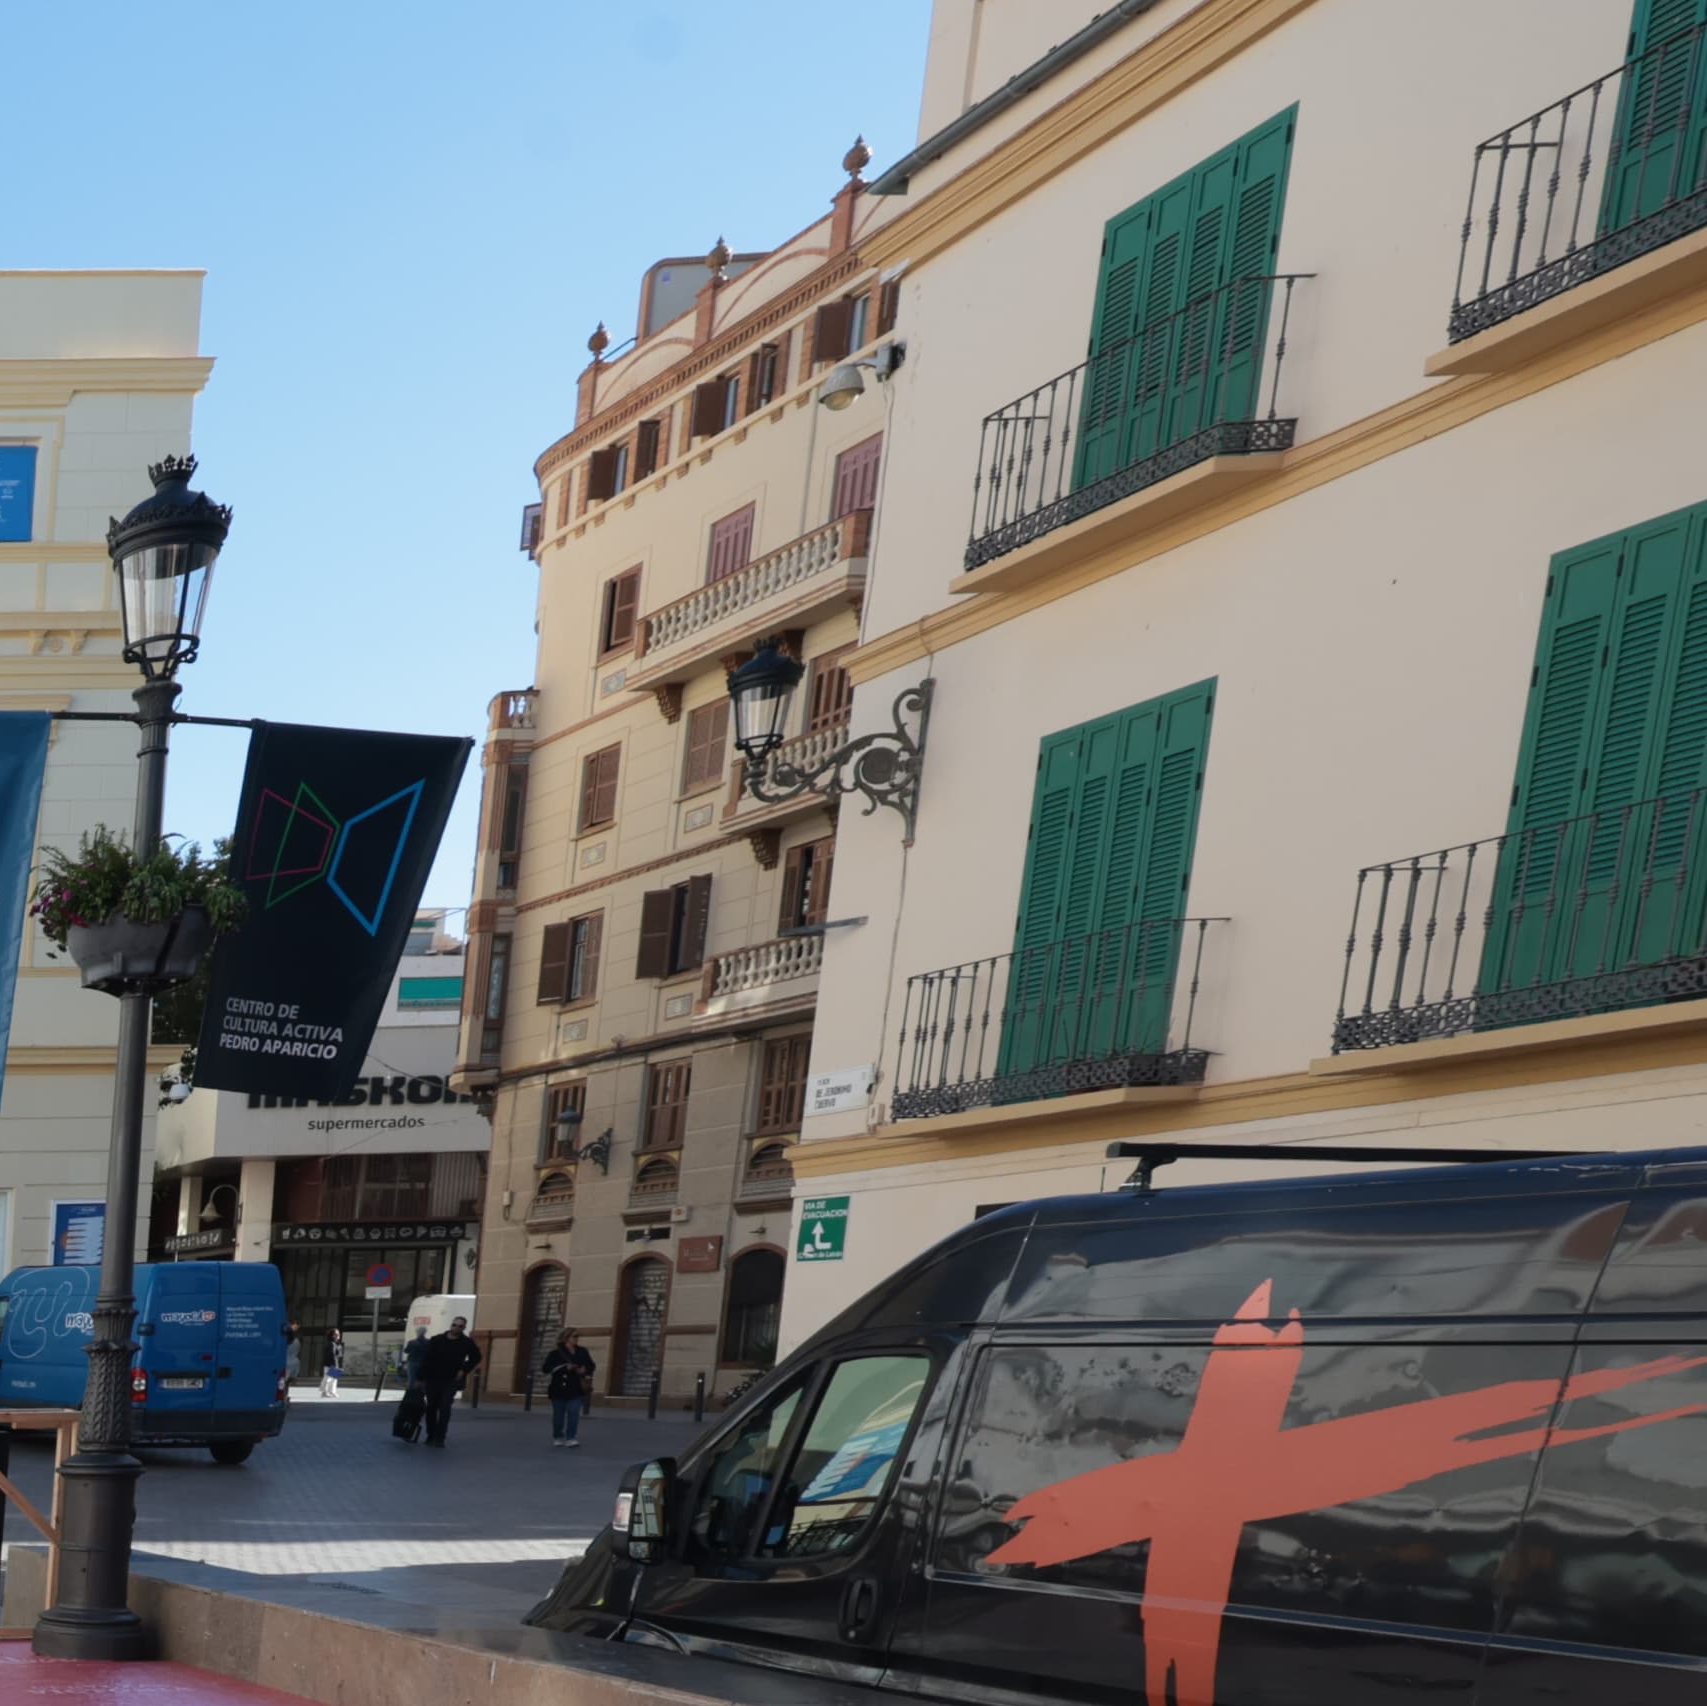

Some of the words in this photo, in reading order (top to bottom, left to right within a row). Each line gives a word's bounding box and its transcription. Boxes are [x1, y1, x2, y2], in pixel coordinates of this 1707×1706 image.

[225, 997, 274, 1017] CENTRO
[277, 1002, 299, 1020] DE
[223, 1015, 278, 1036] CULTURA
[282, 1023, 344, 1043] ACTIVA
[219, 1033, 260, 1052] PEDRO
[262, 1040, 338, 1060] APARICIO
[308, 1115, 425, 1132] supermercados
